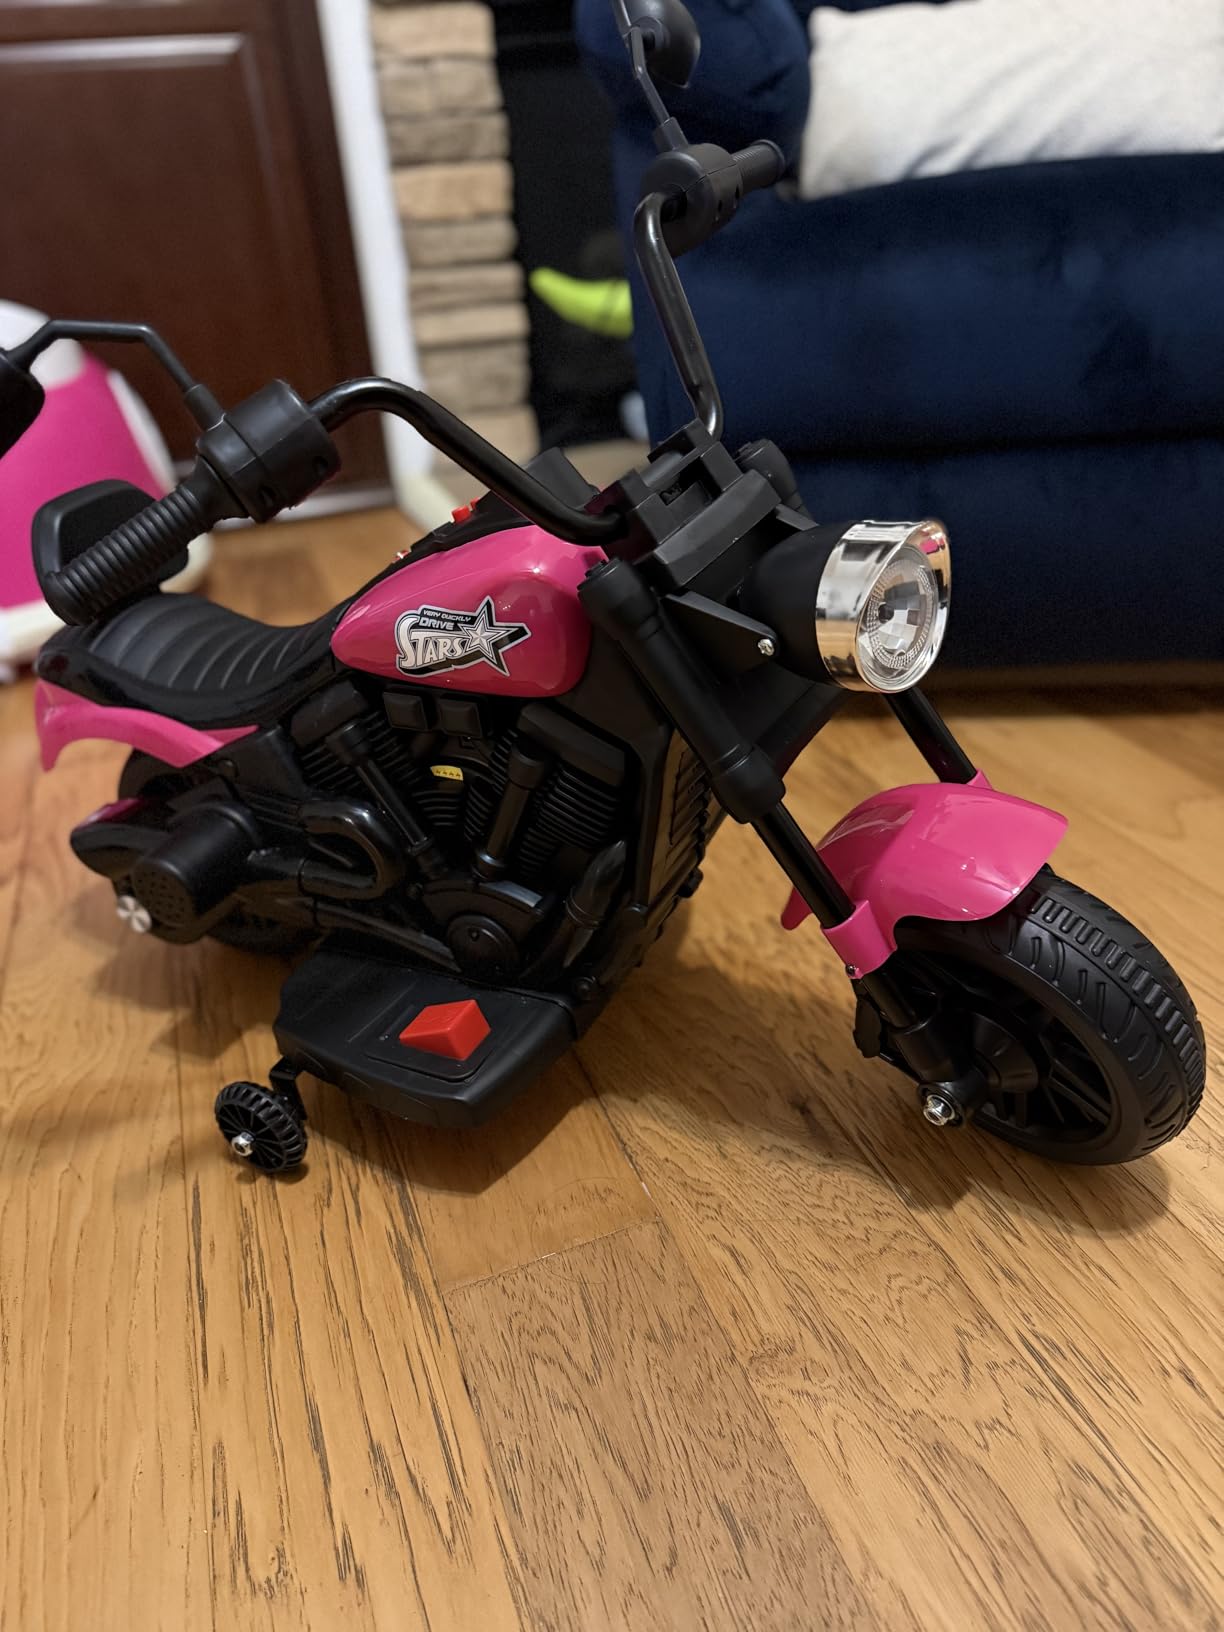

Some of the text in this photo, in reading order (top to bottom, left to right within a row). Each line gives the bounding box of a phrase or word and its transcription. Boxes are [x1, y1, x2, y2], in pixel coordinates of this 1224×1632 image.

[423, 609, 471, 622] VERY QUICKLY
[419, 617, 455, 631] DRIVE
[399, 615, 468, 668] STARS
